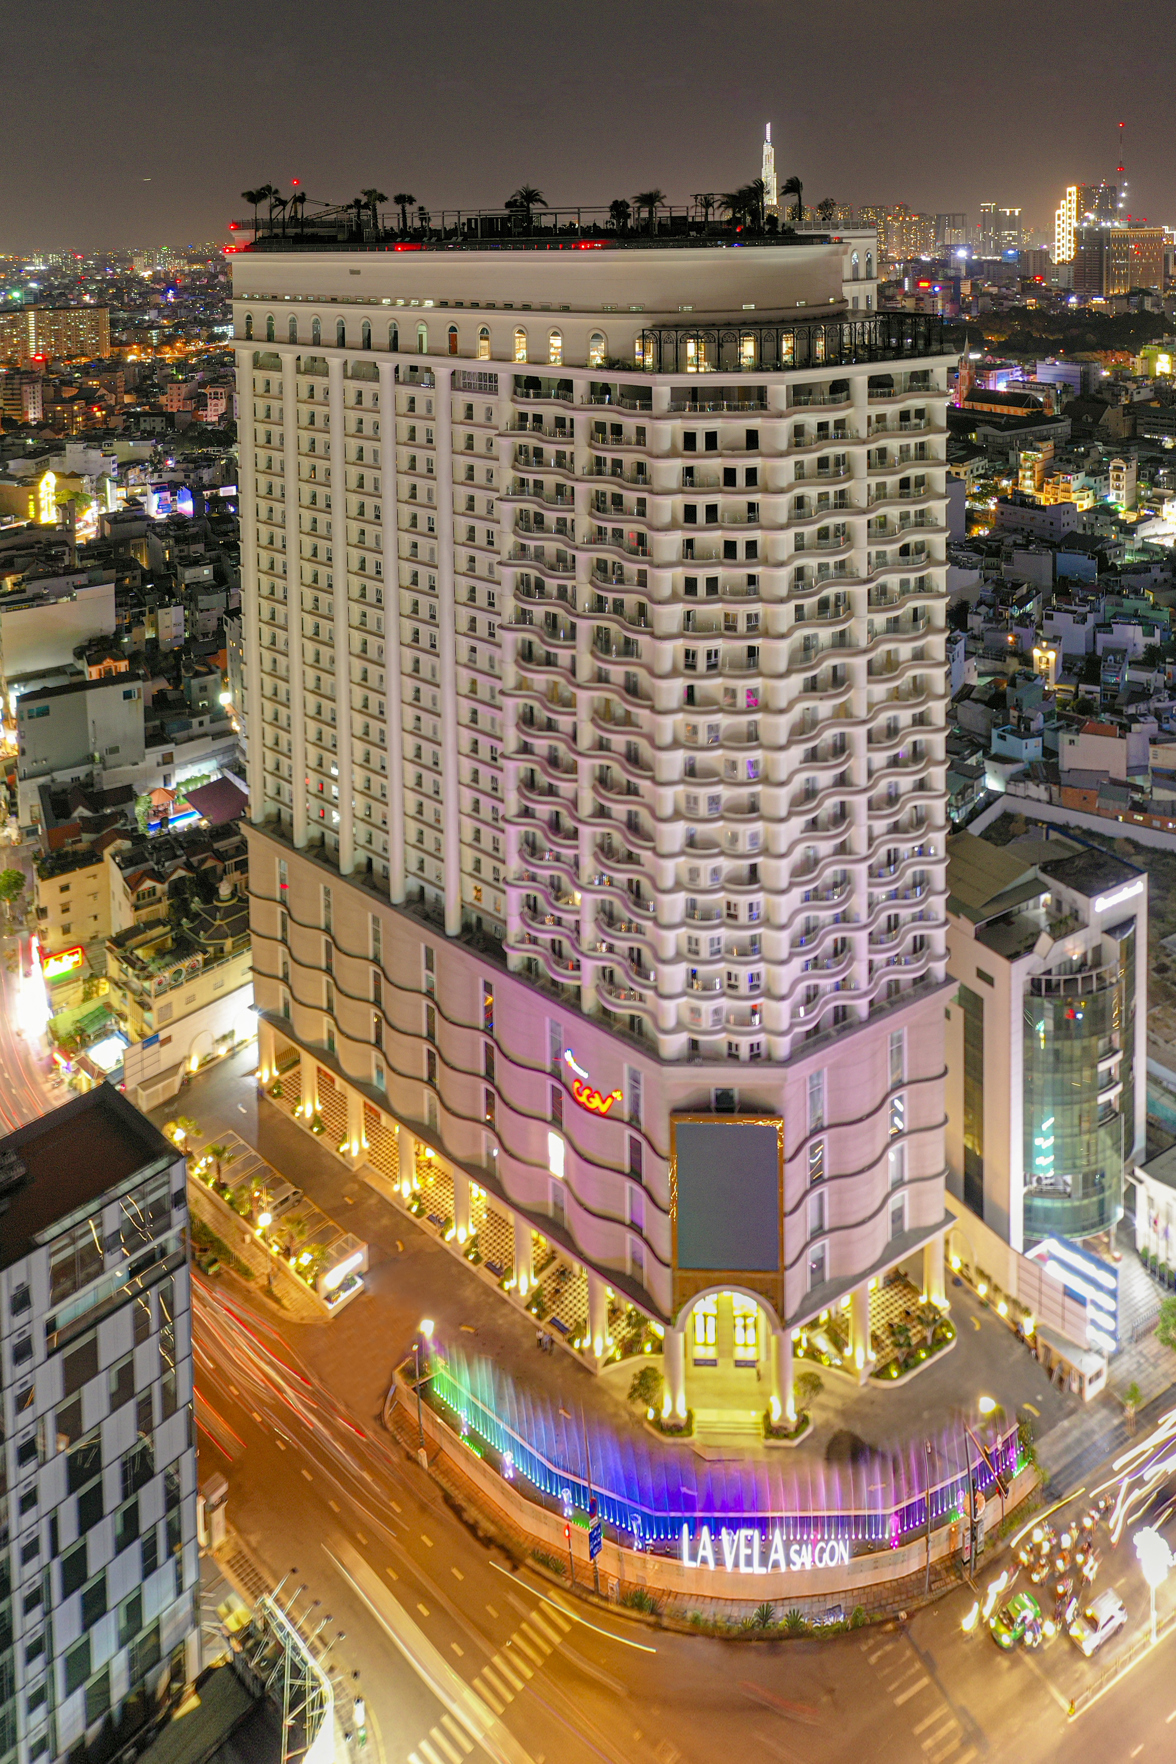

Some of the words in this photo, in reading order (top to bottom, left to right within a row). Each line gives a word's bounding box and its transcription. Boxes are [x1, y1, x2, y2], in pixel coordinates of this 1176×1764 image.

[572, 1079, 614, 1114] CGV
[682, 1522, 715, 1571] LA
[721, 1526, 786, 1574] VELA
[789, 1540, 850, 1571] SAIGON
